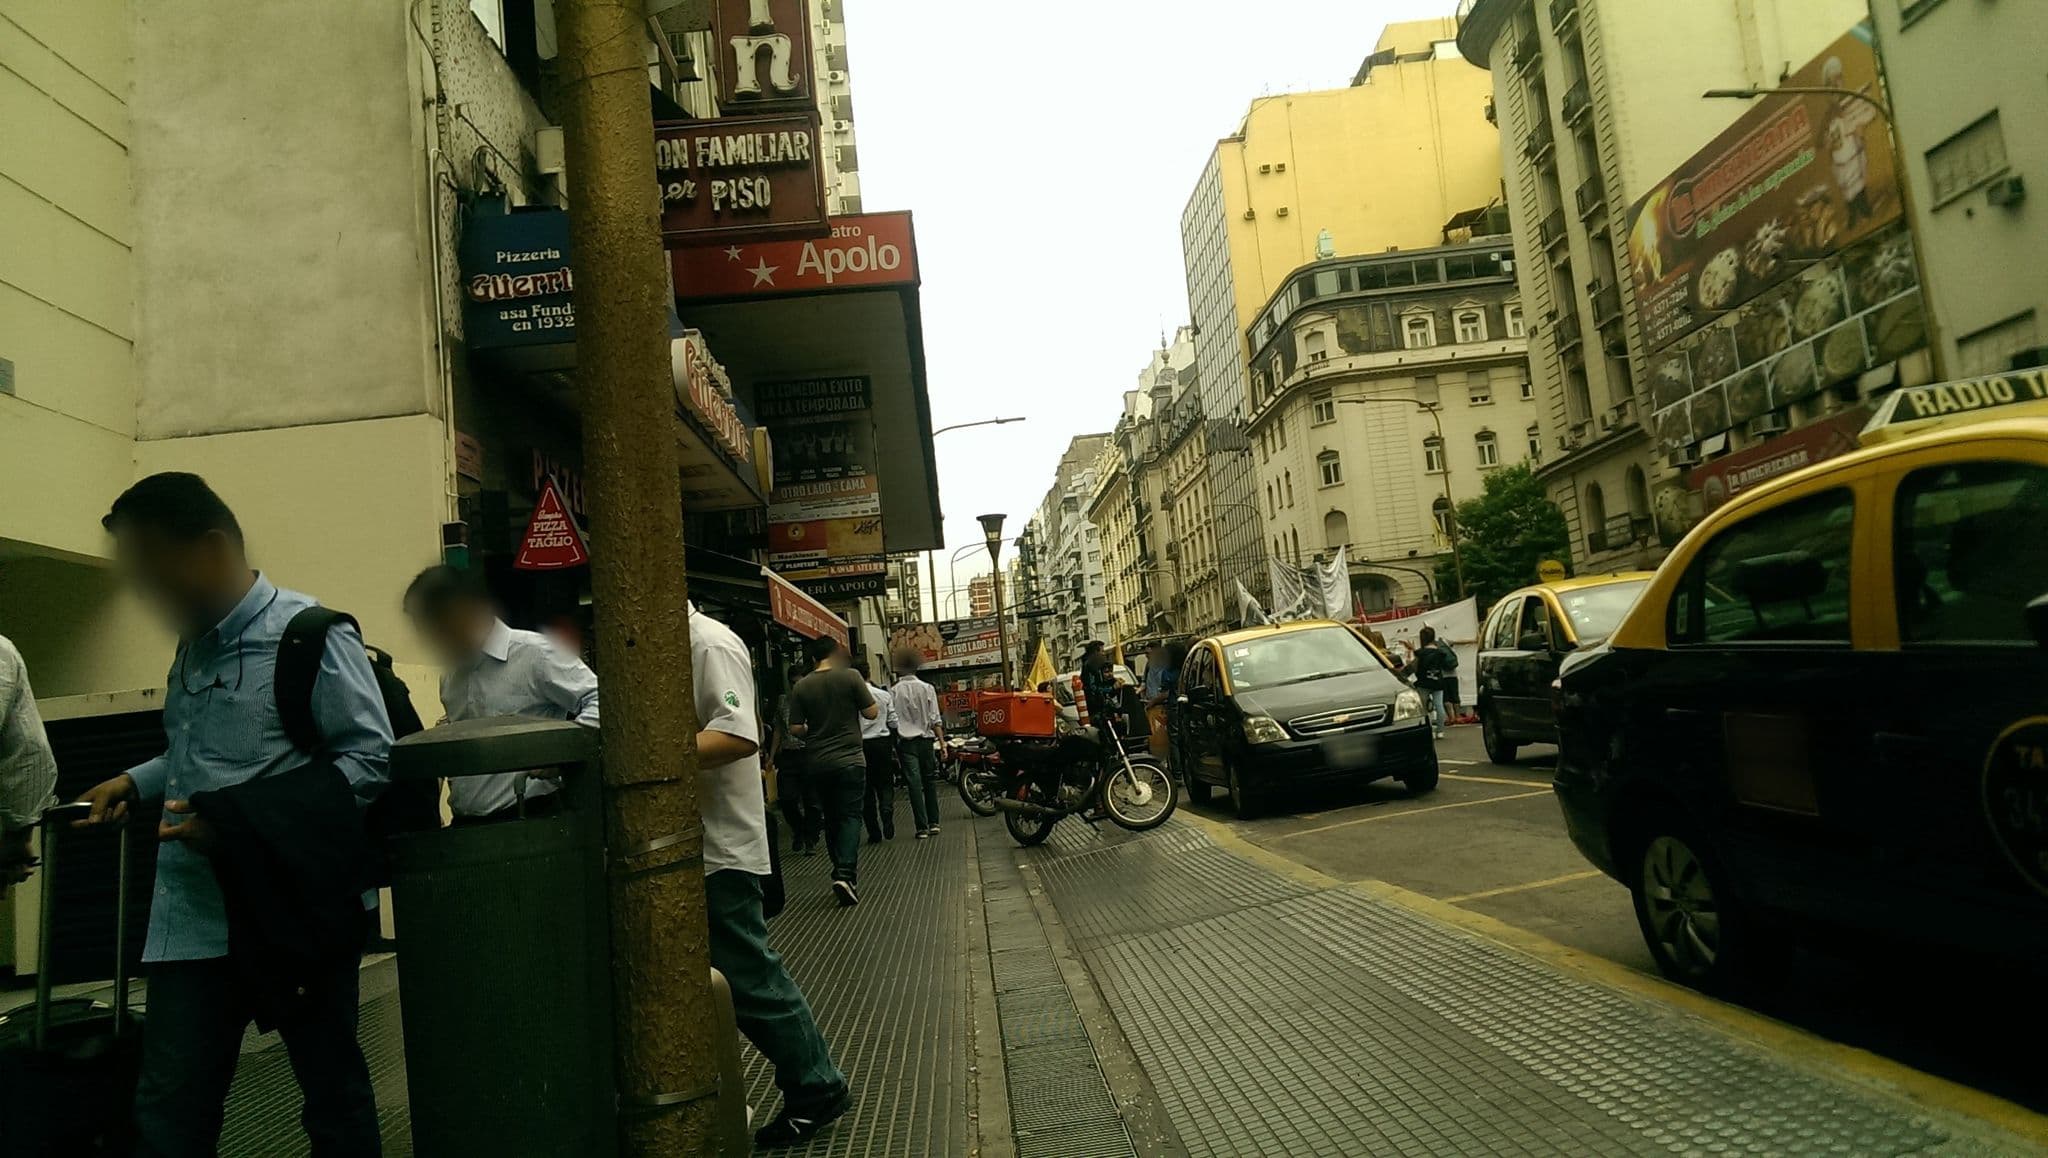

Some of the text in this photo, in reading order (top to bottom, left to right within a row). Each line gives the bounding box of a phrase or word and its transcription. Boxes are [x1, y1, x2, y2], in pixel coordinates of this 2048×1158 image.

[695, 130, 811, 169] FAMILIAR
[711, 175, 772, 212] PISO
[495, 248, 561, 264] Pizzeria
[797, 234, 901, 283] Apolo
[531, 302, 576, 317] Fund
[512, 315, 576, 332] en 1932
[1907, 376, 2016, 416] RADIO
[796, 396, 866, 415] TEMPORADA
[808, 481, 832, 495] LADO
[840, 478, 867, 492] CAMA
[533, 520, 568, 532] PIZZA
[528, 536, 573, 548] TAGLIO
[837, 580, 877, 592] APOLO
[905, 563, 920, 623] LORCA
